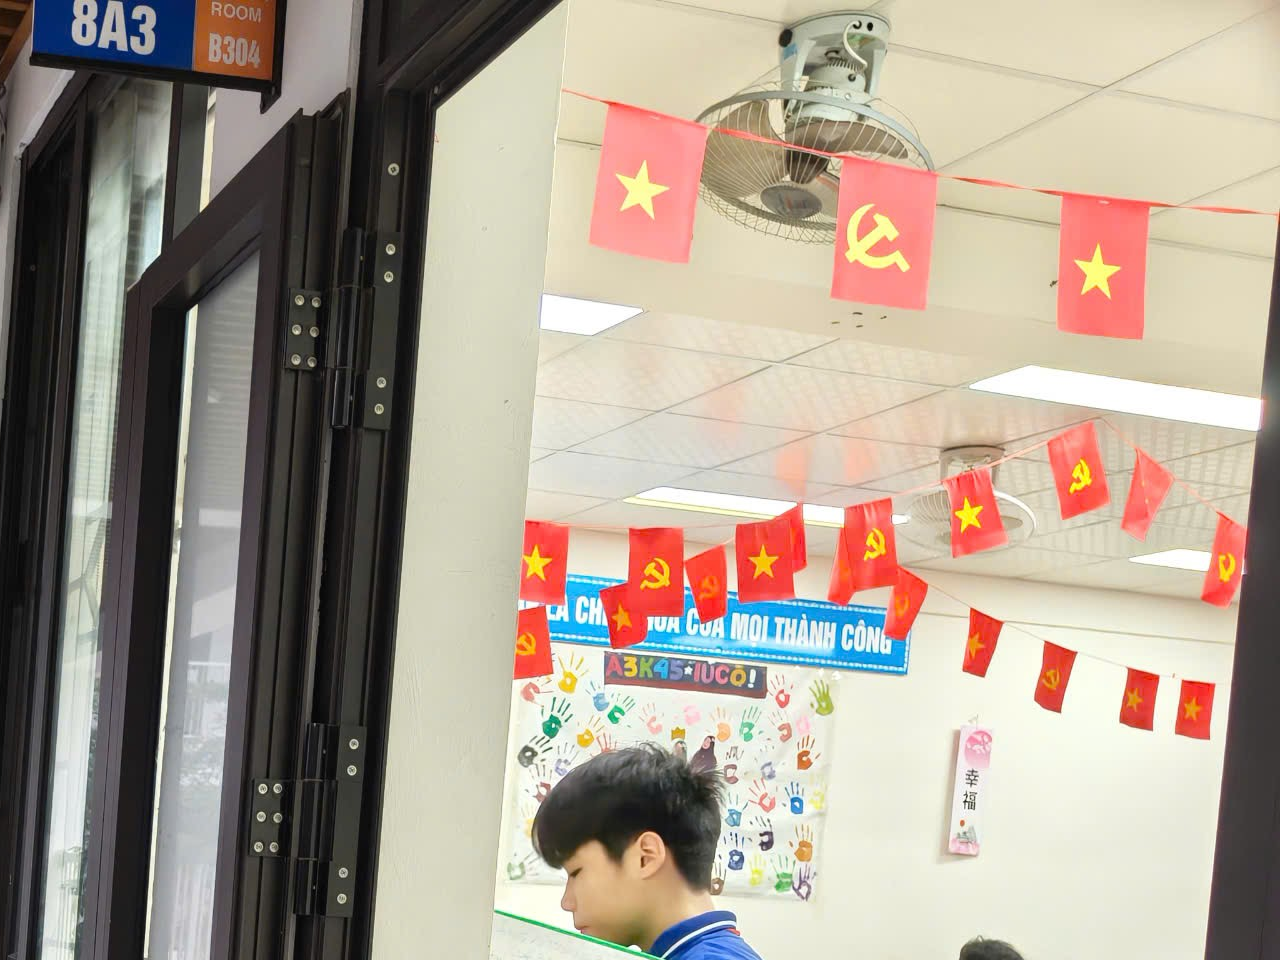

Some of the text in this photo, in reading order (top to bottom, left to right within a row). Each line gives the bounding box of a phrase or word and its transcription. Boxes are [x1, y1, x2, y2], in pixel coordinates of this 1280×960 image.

[71, 0, 157, 56] 8A3
[211, 2, 262, 24] ROOM
[208, 32, 262, 69] B304
[730, 612, 769, 648] MỌI
[775, 613, 837, 649] THÀNH
[841, 619, 892, 655] CÔNG
[962, 768, 980, 811] 幸福
